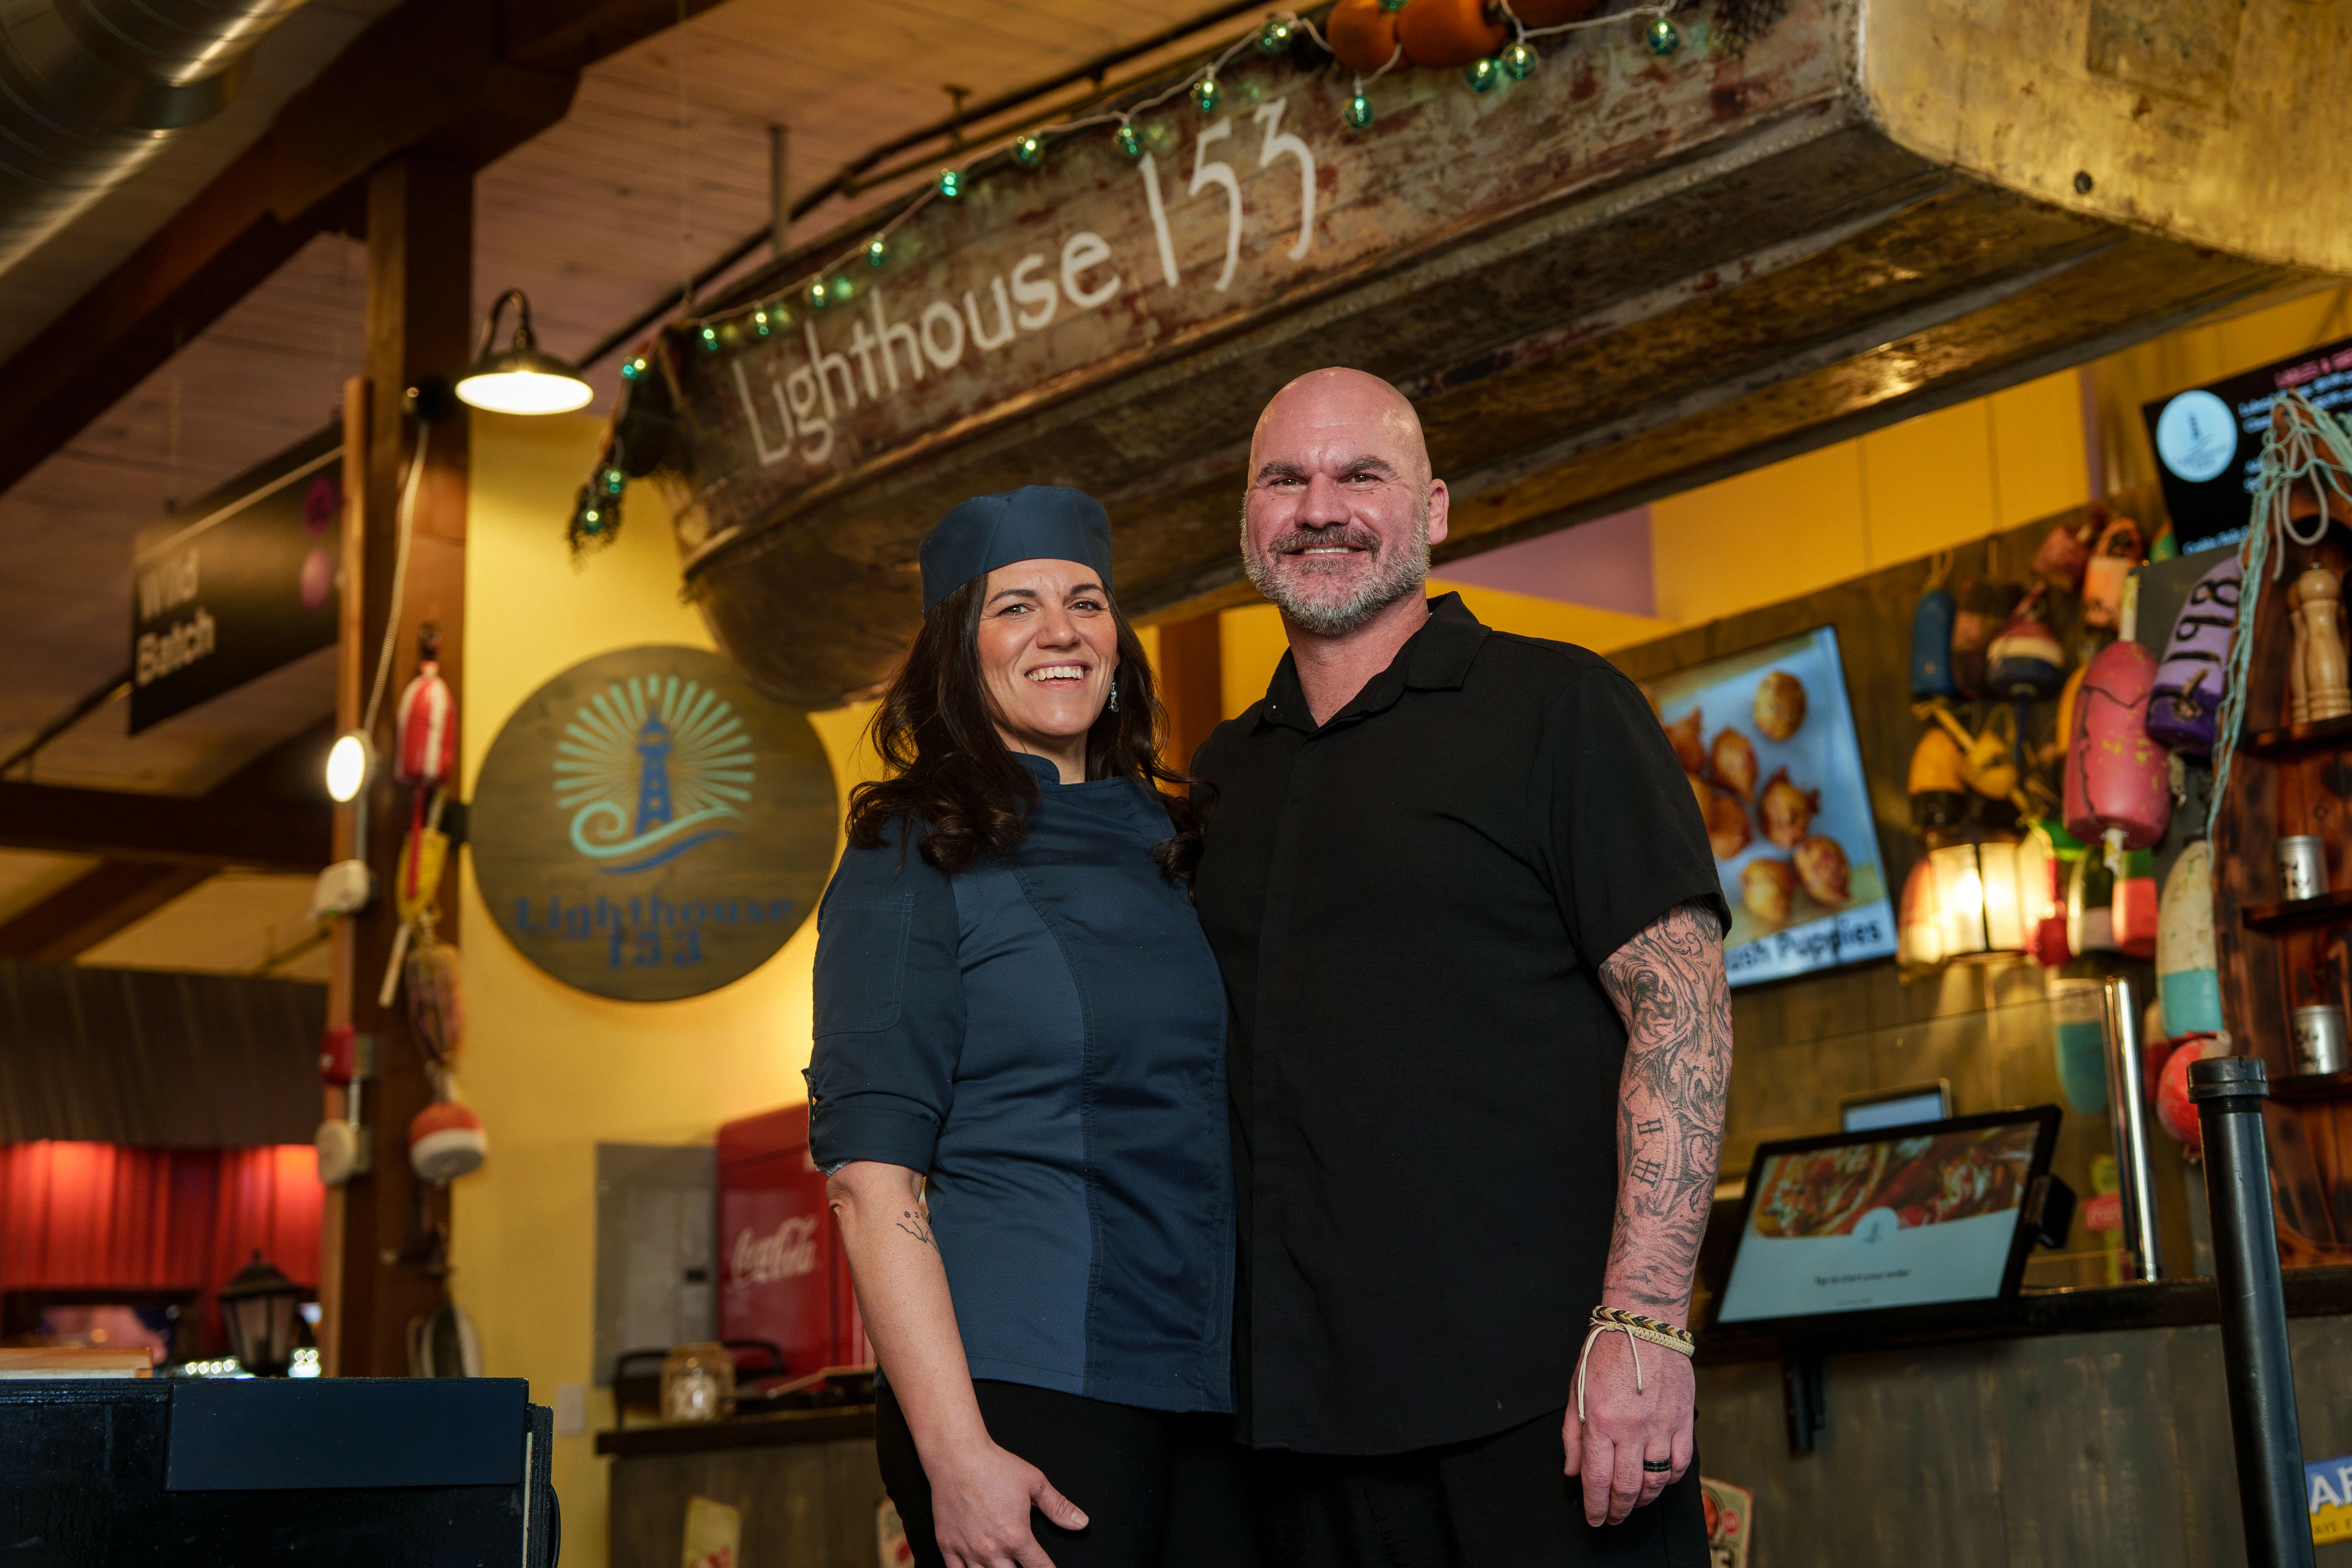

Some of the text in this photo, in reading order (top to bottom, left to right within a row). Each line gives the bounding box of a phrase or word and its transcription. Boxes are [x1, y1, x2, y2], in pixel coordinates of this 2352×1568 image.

[731, 95, 1317, 467] Lighthouse 153
[136, 606, 216, 688] Batch
[517, 896, 794, 941] Lighthouse
[1775, 916, 1882, 963] Puppies
[609, 931, 703, 969] 153
